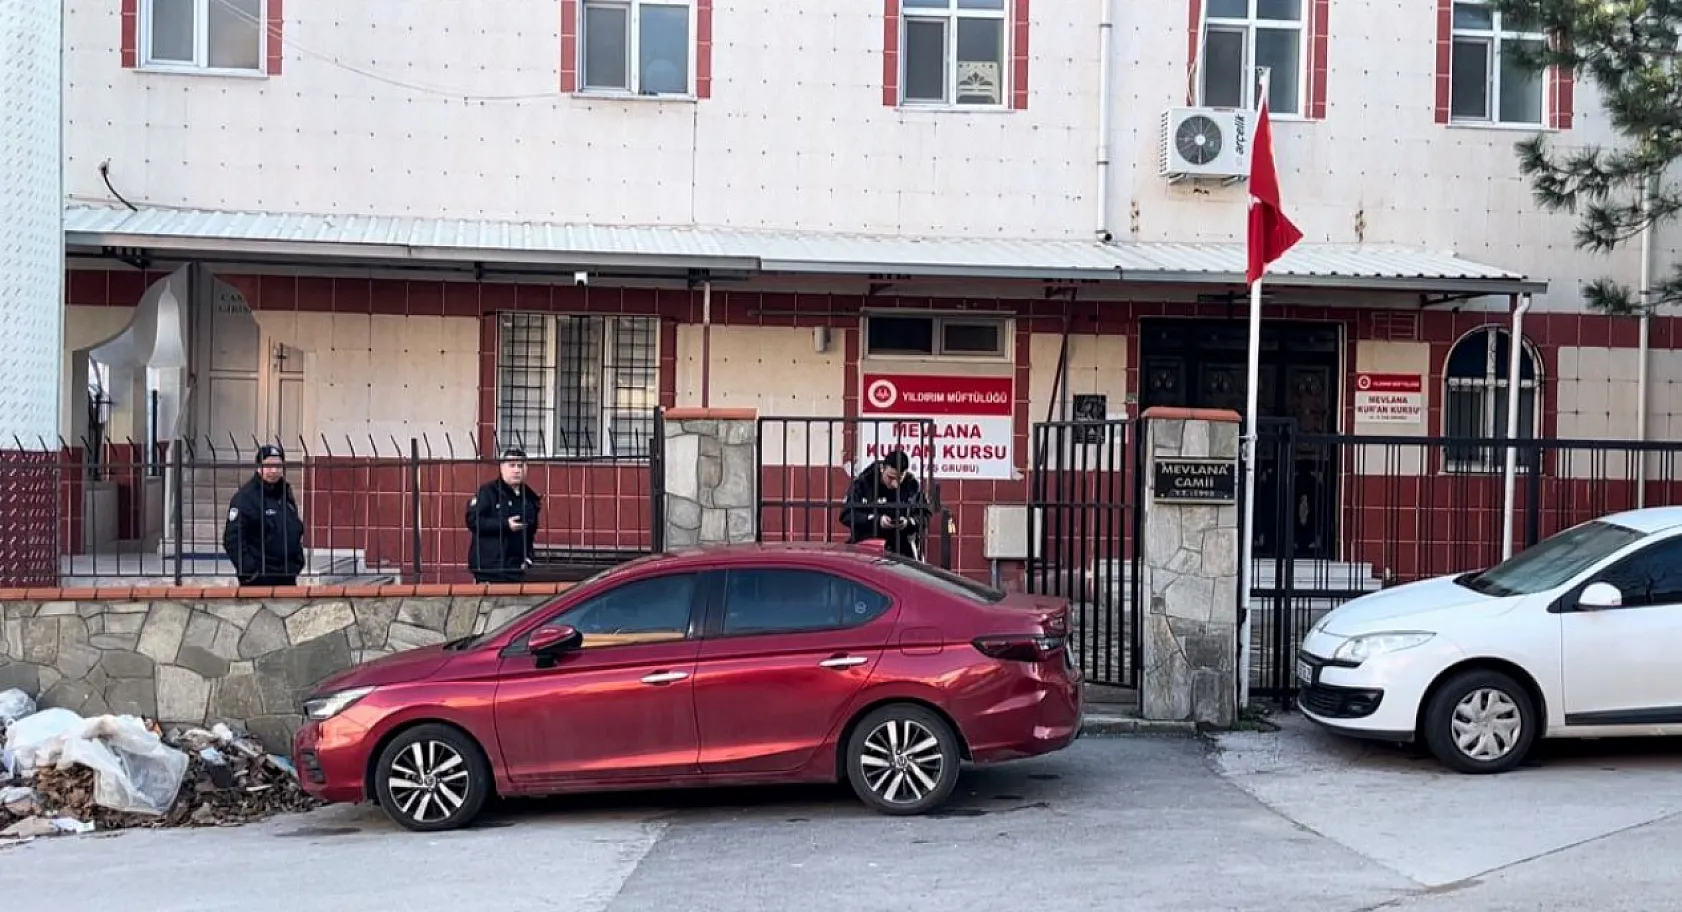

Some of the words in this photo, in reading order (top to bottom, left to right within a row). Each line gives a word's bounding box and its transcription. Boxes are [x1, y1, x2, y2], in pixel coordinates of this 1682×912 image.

[1234, 112, 1246, 155] arçelik
[902, 391, 944, 403] YILDIRIM
[947, 390, 1007, 403] MÜFTÜLÜĞÜ
[1368, 396, 1408, 404] MEVLANA
[942, 444, 1007, 460] KURSU
[941, 463, 980, 474] GRUBU)
[1161, 463, 1228, 475] MEVLANA
